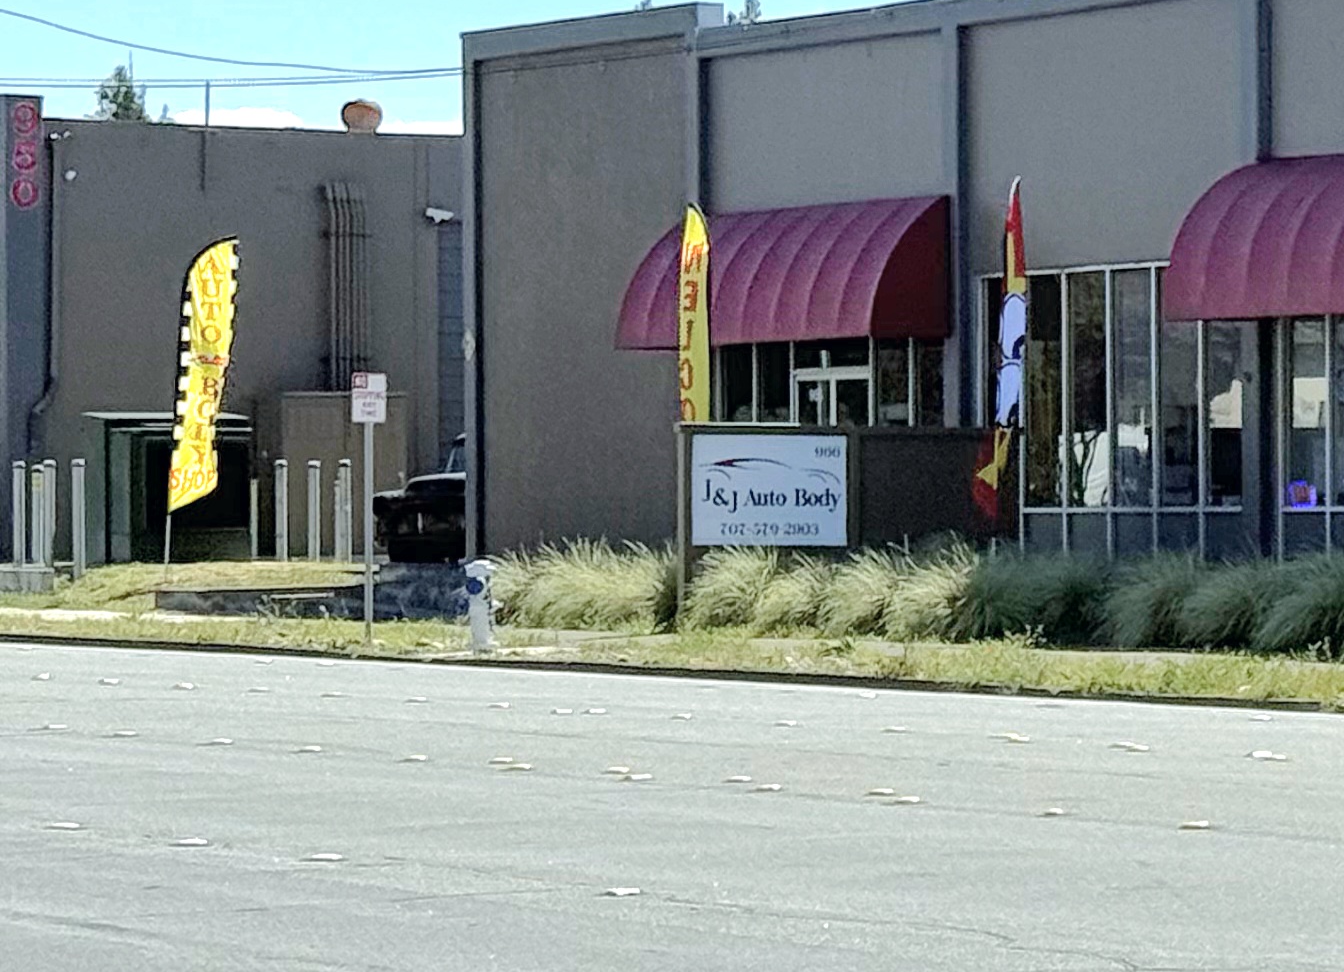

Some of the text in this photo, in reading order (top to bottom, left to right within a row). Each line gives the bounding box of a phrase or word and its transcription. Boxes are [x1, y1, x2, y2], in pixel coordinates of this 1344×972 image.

[200, 254, 226, 345] AUTO
[744, 489, 787, 507] Auto
[795, 488, 841, 513] Body
